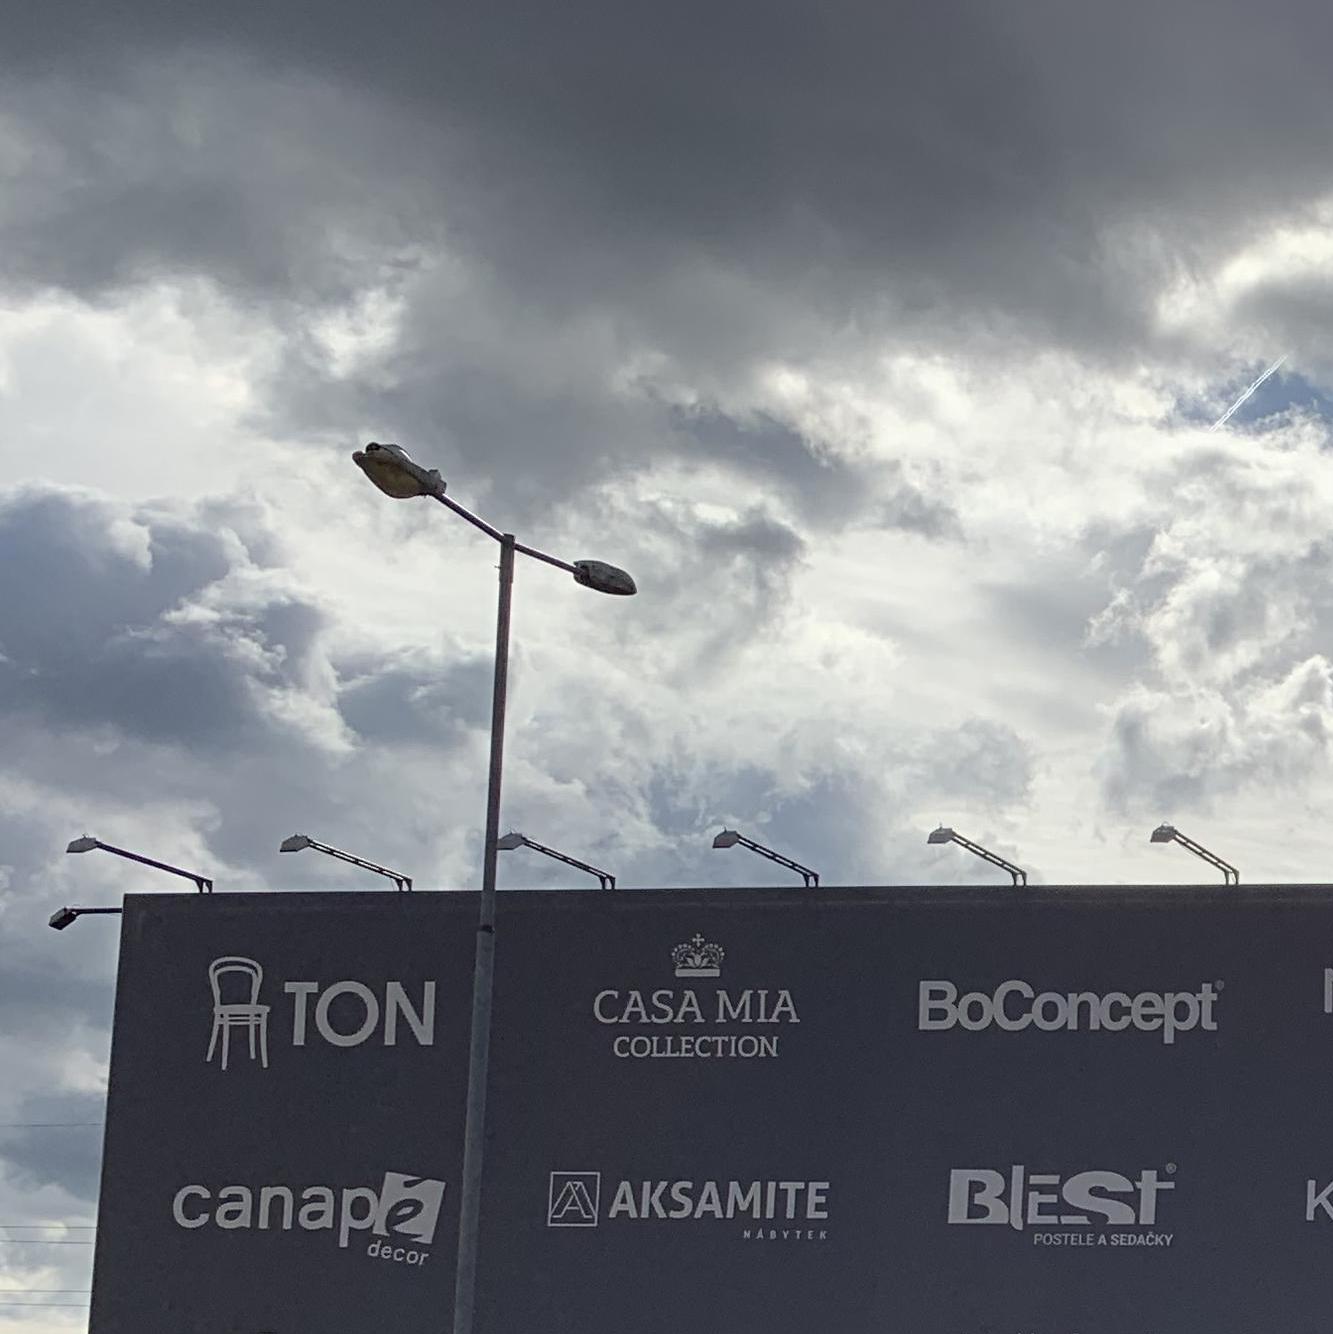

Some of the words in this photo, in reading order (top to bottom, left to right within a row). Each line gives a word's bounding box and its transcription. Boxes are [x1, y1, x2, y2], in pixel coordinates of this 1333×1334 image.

[284, 980, 436, 1047] TON
[594, 989, 706, 1024] CASA
[716, 989, 801, 1024] MIA
[613, 1035, 779, 1058] COLLECTION
[608, 1180, 830, 1219] AKSAMITE
[743, 1228, 828, 1240] NÁBYTEK
[1033, 1233, 1095, 1246] POSTELE
[1097, 1234, 1108, 1246] A
[1110, 1231, 1174, 1247] SEDAČKY
[366, 1238, 430, 1266] decor
